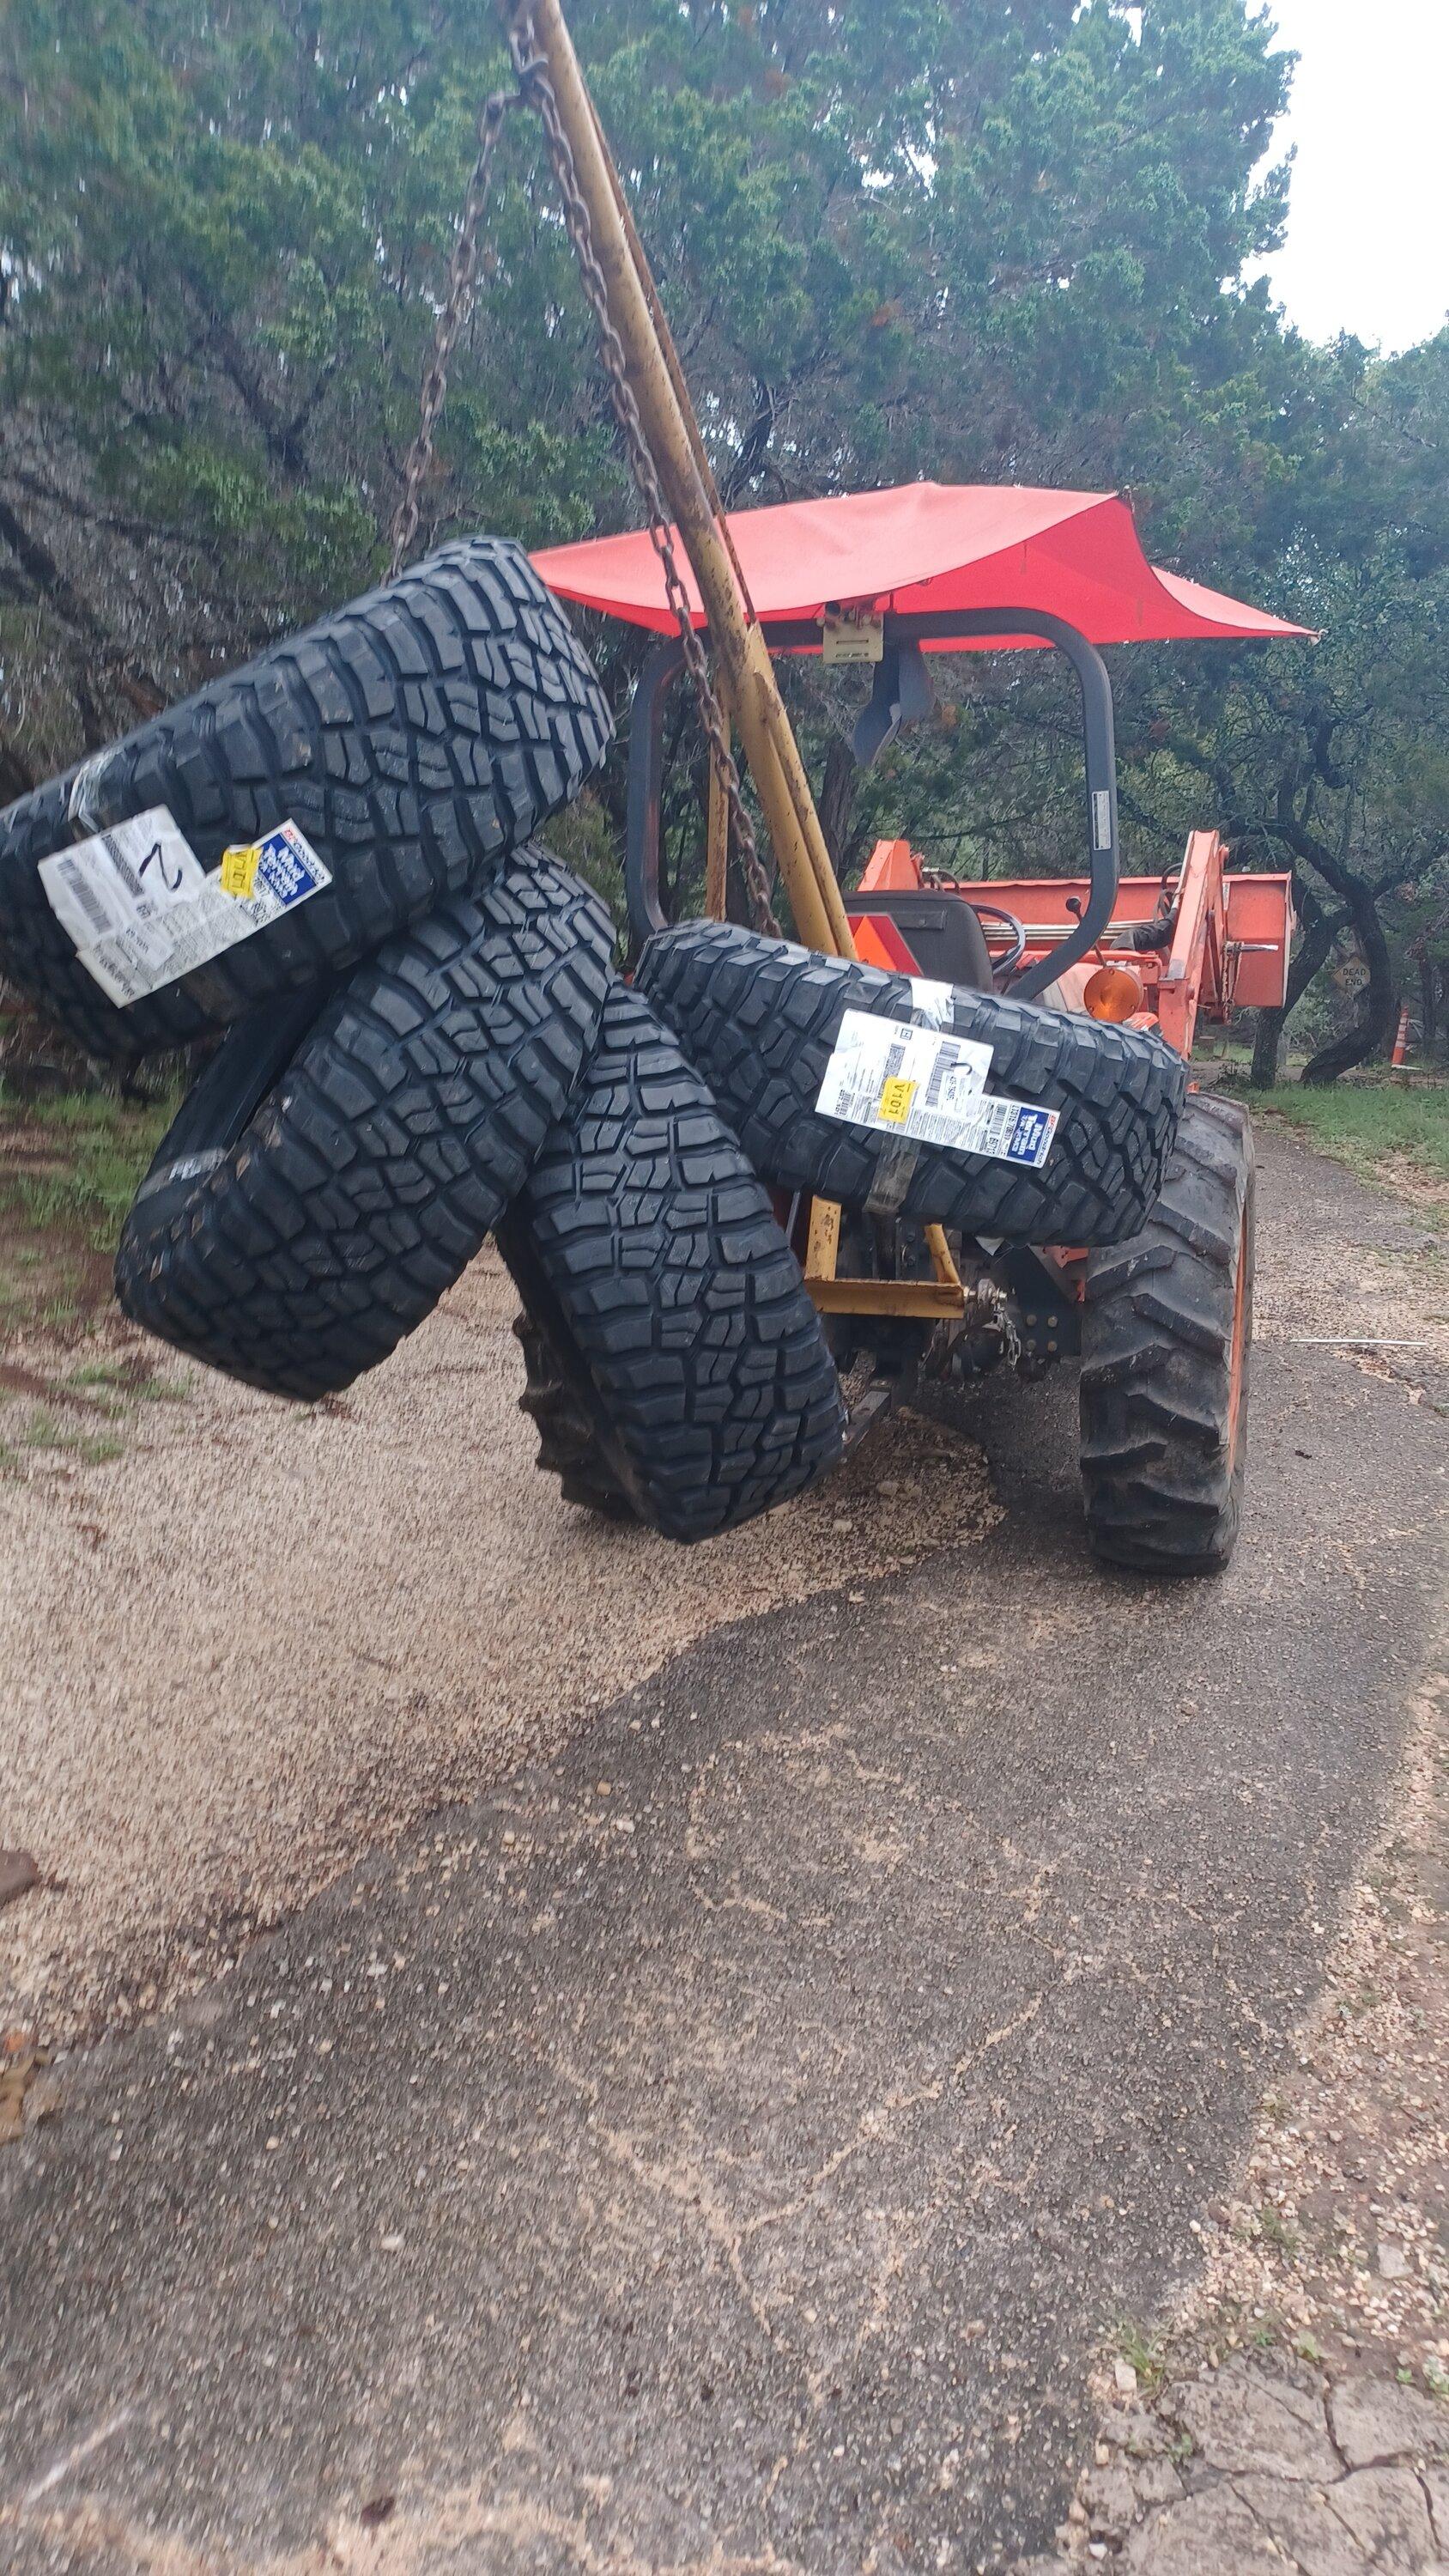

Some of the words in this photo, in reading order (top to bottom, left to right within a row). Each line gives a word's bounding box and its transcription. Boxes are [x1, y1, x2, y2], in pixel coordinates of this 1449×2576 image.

[263, 842, 298, 896] Terrain
[275, 844, 305, 882] Mud
[1343, 968, 1366, 976] DEAD
[1017, 1115, 1037, 1156] Terrain
[1028, 1122, 1043, 1151] Mud
